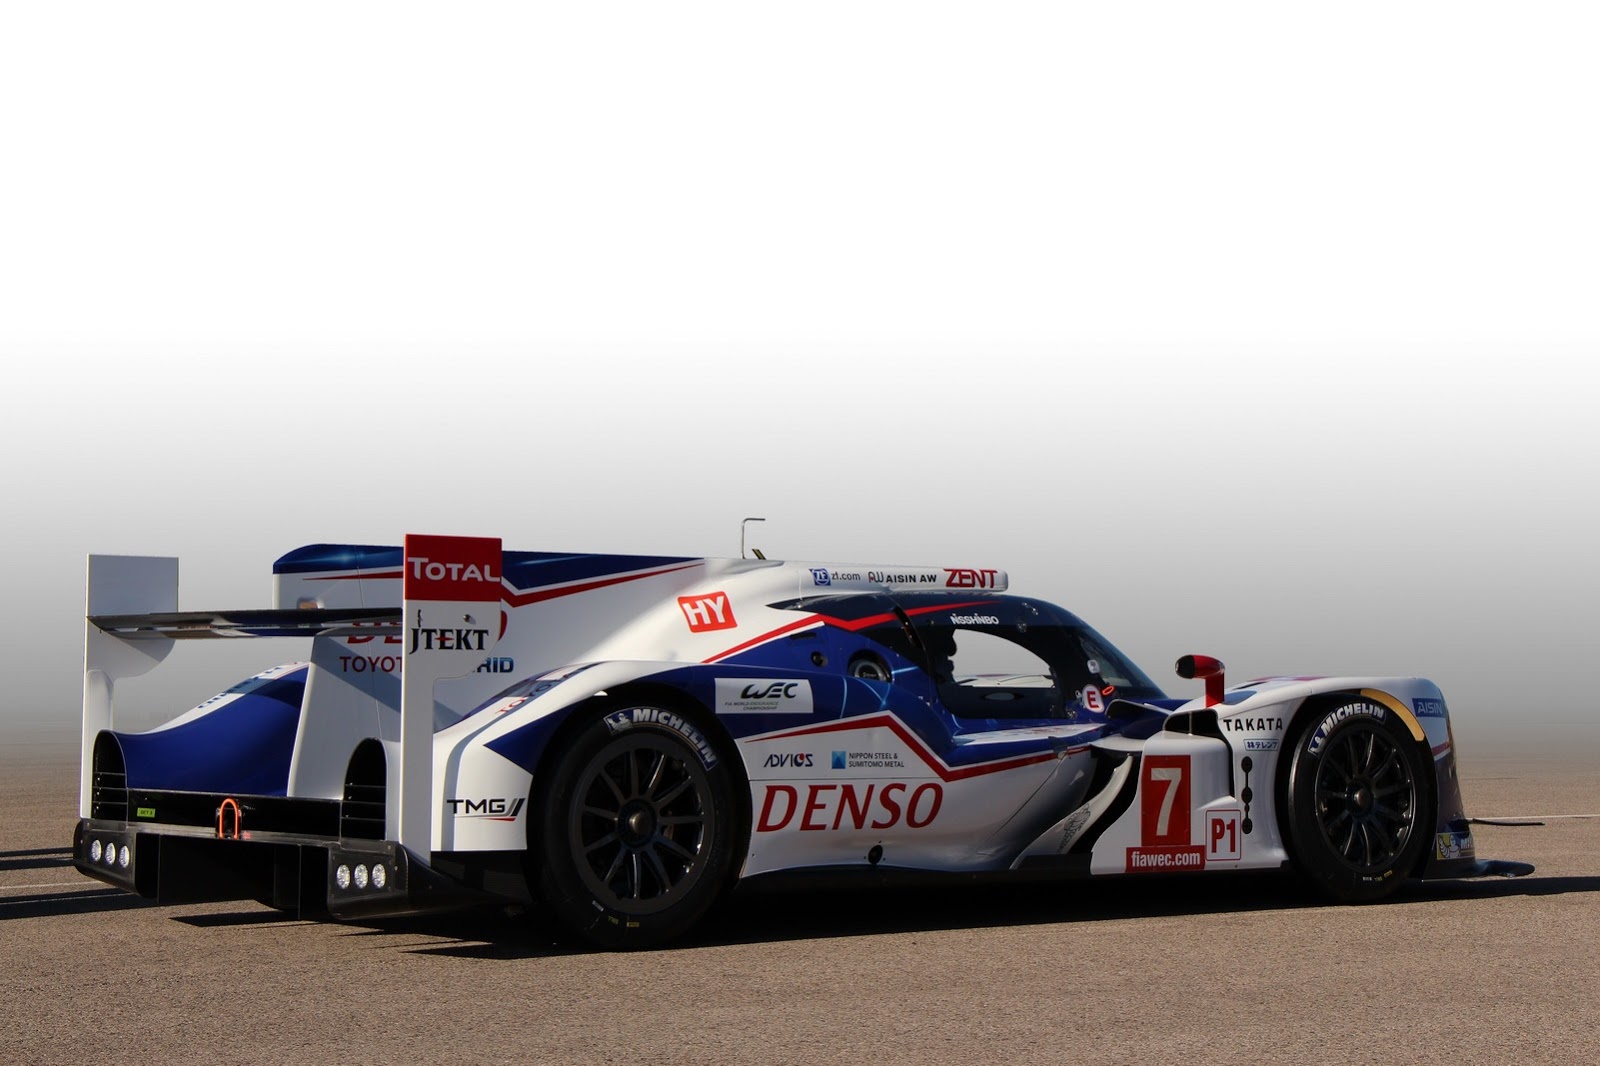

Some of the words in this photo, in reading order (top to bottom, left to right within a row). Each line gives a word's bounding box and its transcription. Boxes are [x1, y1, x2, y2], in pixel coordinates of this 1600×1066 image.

[408, 557, 501, 582] TOTAL
[943, 568, 998, 588] ZENT
[886, 574, 917, 583] AISIN
[919, 574, 937, 583] AW
[682, 595, 726, 626] HY
[409, 627, 489, 655] JTEKT
[340, 656, 402, 673] TOYOT
[740, 682, 798, 699] WEC
[1086, 691, 1099, 708] E
[1417, 701, 1443, 714] AISIN
[1223, 718, 1283, 732] TAKATA
[1321, 703, 1384, 736] MICHELIN
[633, 708, 718, 763] MICHELIN
[848, 760, 884, 768] SUMITOMO
[884, 760, 905, 768] METAL
[849, 752, 873, 760] NIPPON
[874, 752, 892, 760] STEEL
[893, 752, 898, 760] &
[447, 798, 506, 814] TMG
[756, 782, 943, 832] DENSO
[1151, 767, 1182, 836] 7
[1211, 818, 1236, 853] P1
[1131, 851, 1201, 868] fiawec.com
